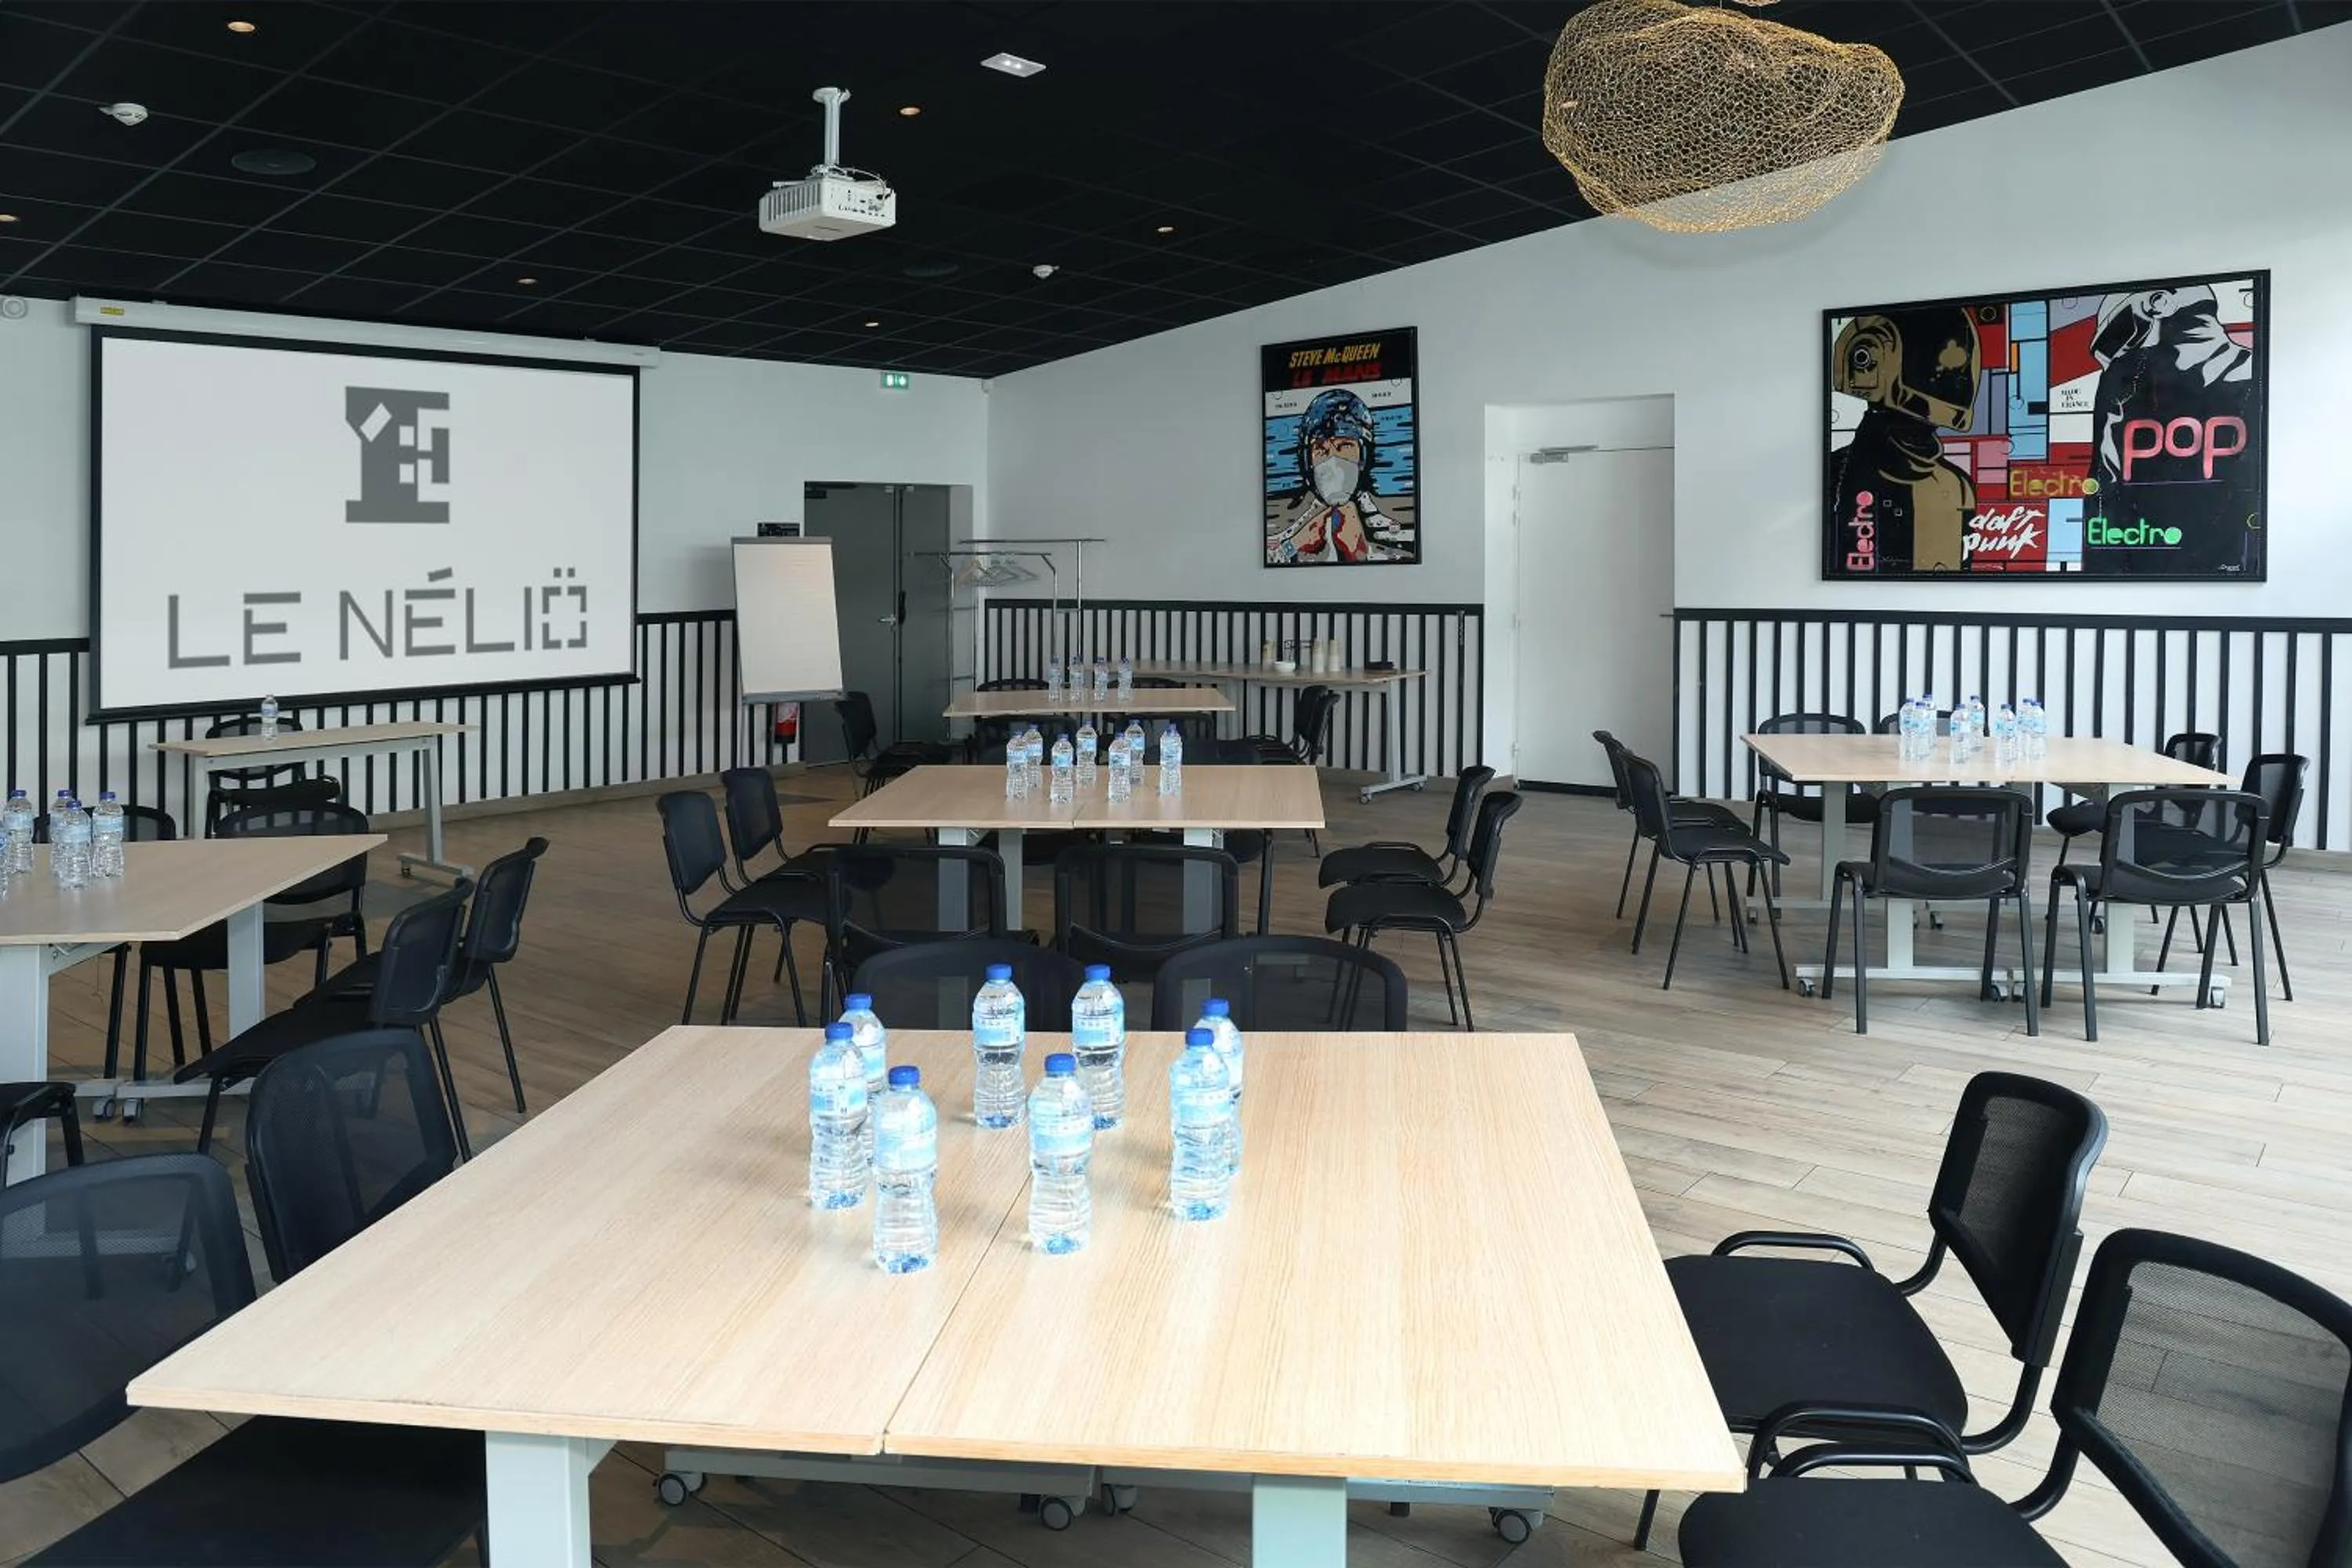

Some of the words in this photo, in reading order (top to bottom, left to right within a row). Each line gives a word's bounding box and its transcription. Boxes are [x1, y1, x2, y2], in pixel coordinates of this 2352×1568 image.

[1289, 350, 1323, 368] STEVE
[2123, 416, 2247, 481] pop
[2009, 470, 2100, 496] Electro
[1846, 490, 1875, 570] Electro
[1969, 506, 2045, 533] daft
[2087, 516, 2183, 545] Electro
[1962, 524, 2045, 561] punk
[168, 591, 302, 669] LE
[339, 567, 587, 660] NÉLIÖ
